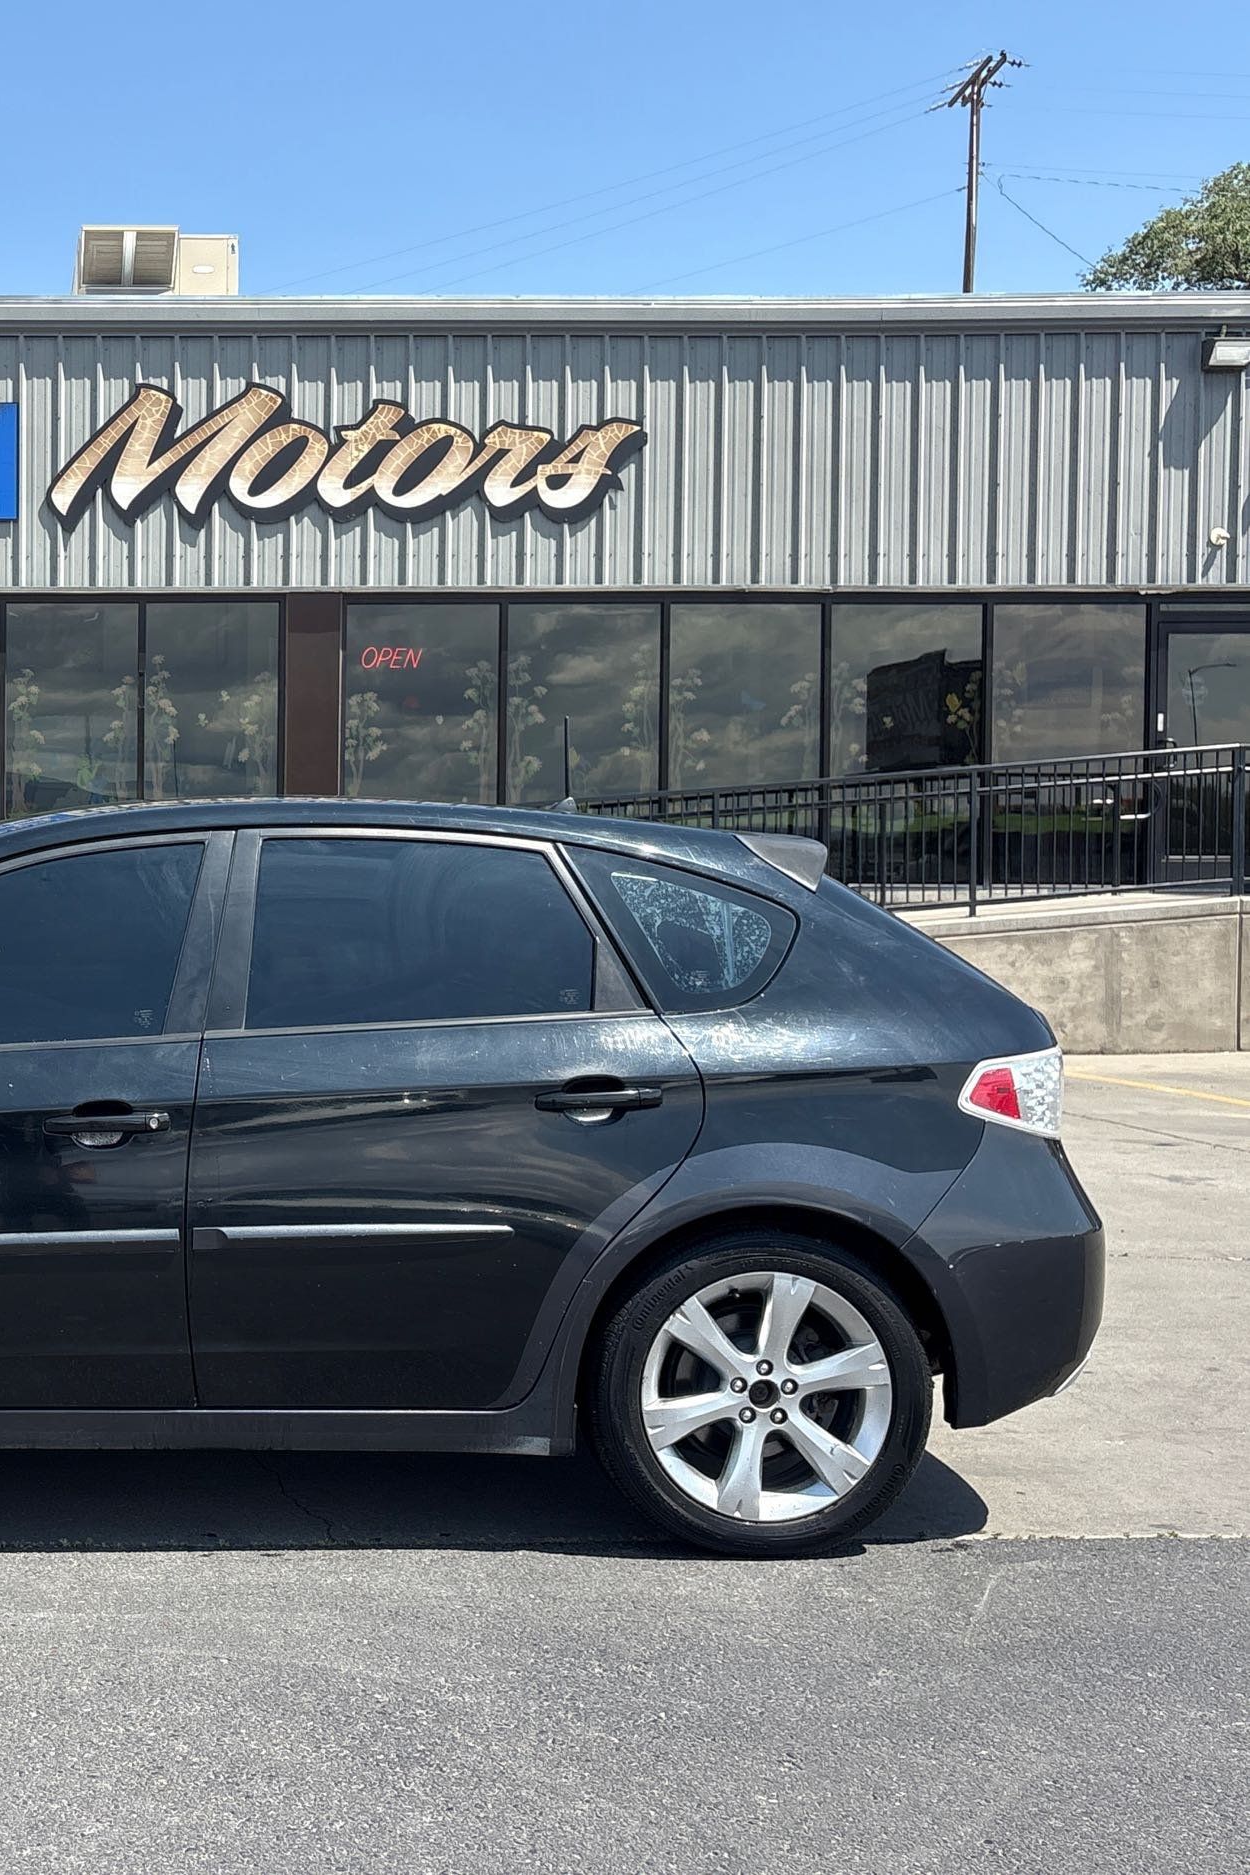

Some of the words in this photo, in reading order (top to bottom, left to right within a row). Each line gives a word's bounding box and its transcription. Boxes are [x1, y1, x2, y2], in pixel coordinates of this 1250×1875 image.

[48, 382, 643, 520] Motors
[361, 646, 423, 669] OPEN
[632, 1269, 686, 1331] Continental
